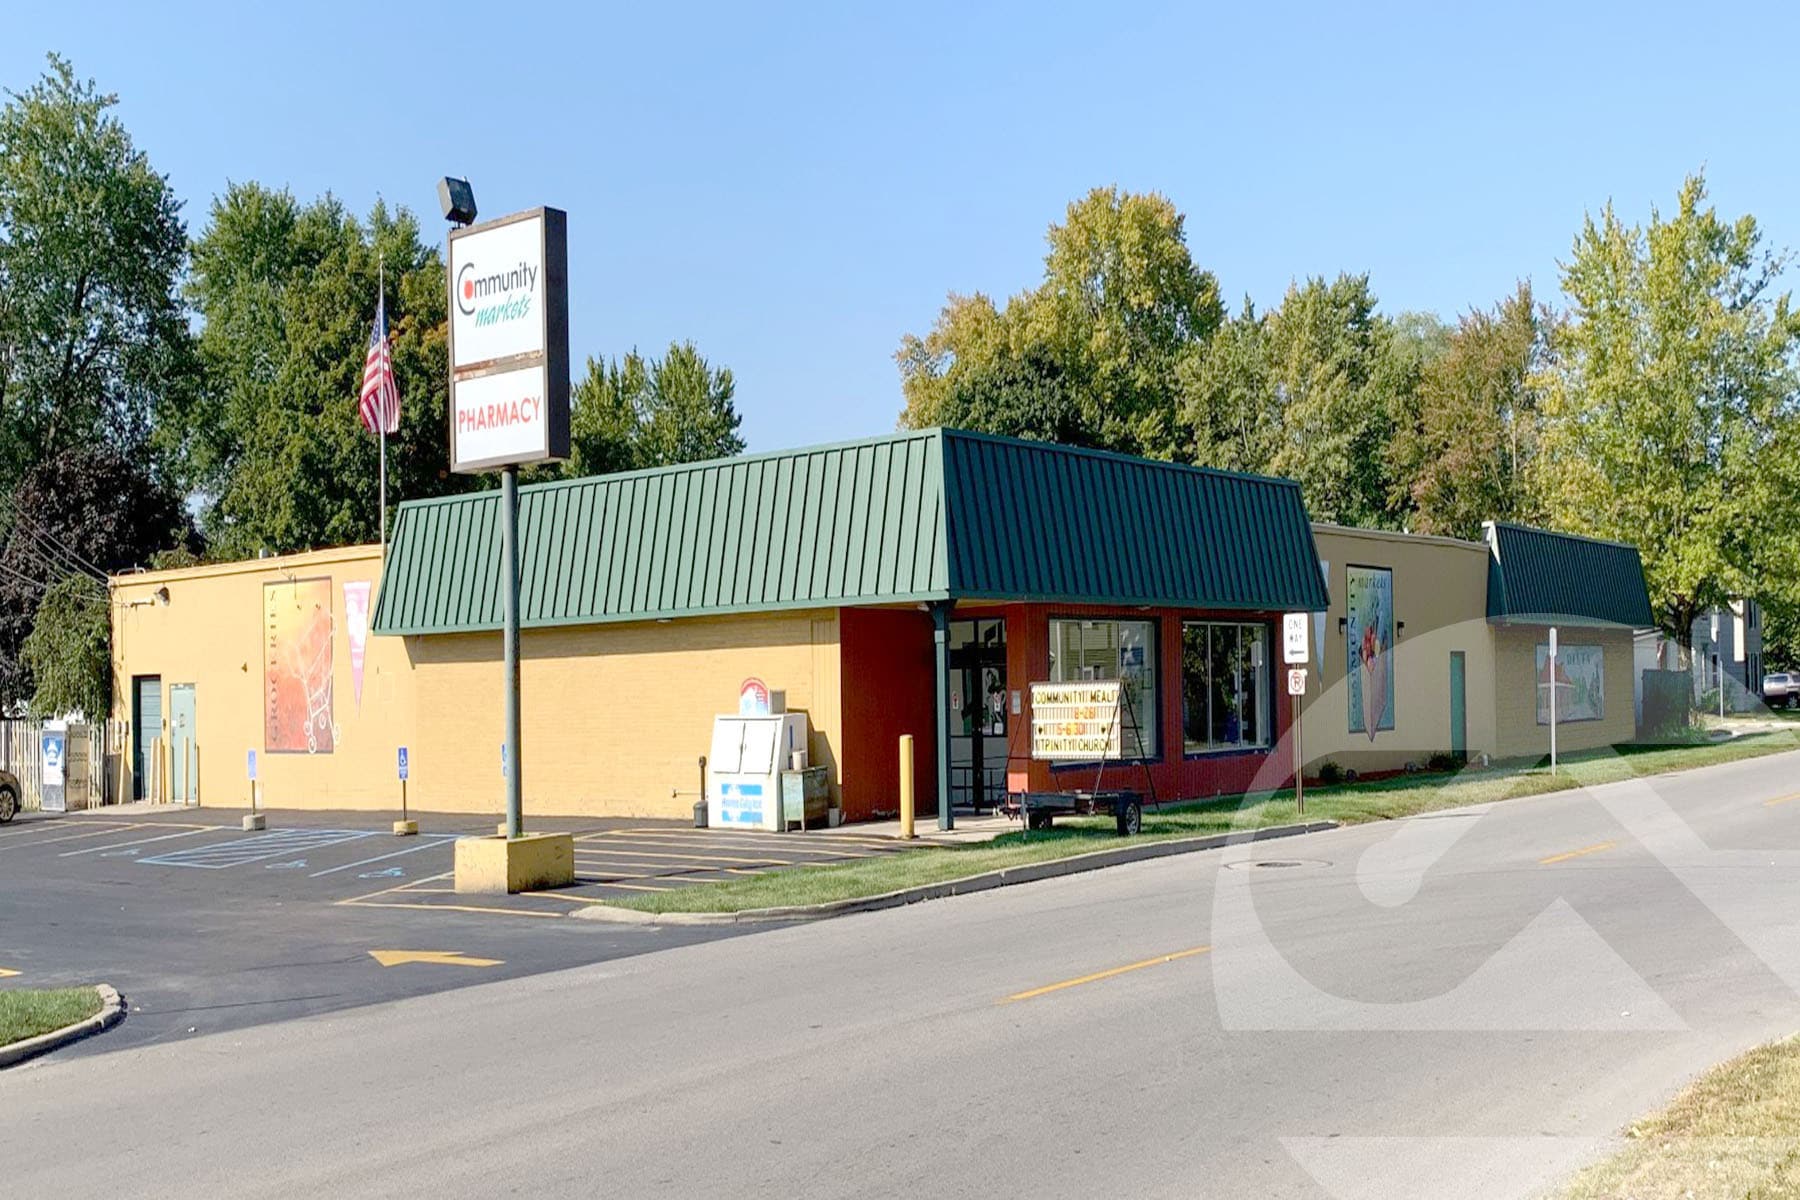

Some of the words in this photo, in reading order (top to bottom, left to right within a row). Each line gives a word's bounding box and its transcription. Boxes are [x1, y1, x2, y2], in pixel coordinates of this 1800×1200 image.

[456, 261, 538, 316] Community
[475, 294, 532, 328] markets
[458, 396, 541, 434] PHARMACY
[1288, 618, 1303, 630] ONE
[1288, 634, 1303, 644] WAY
[1035, 690, 1082, 704] COMMUNITY
[1078, 738, 1112, 752] CHURCH
